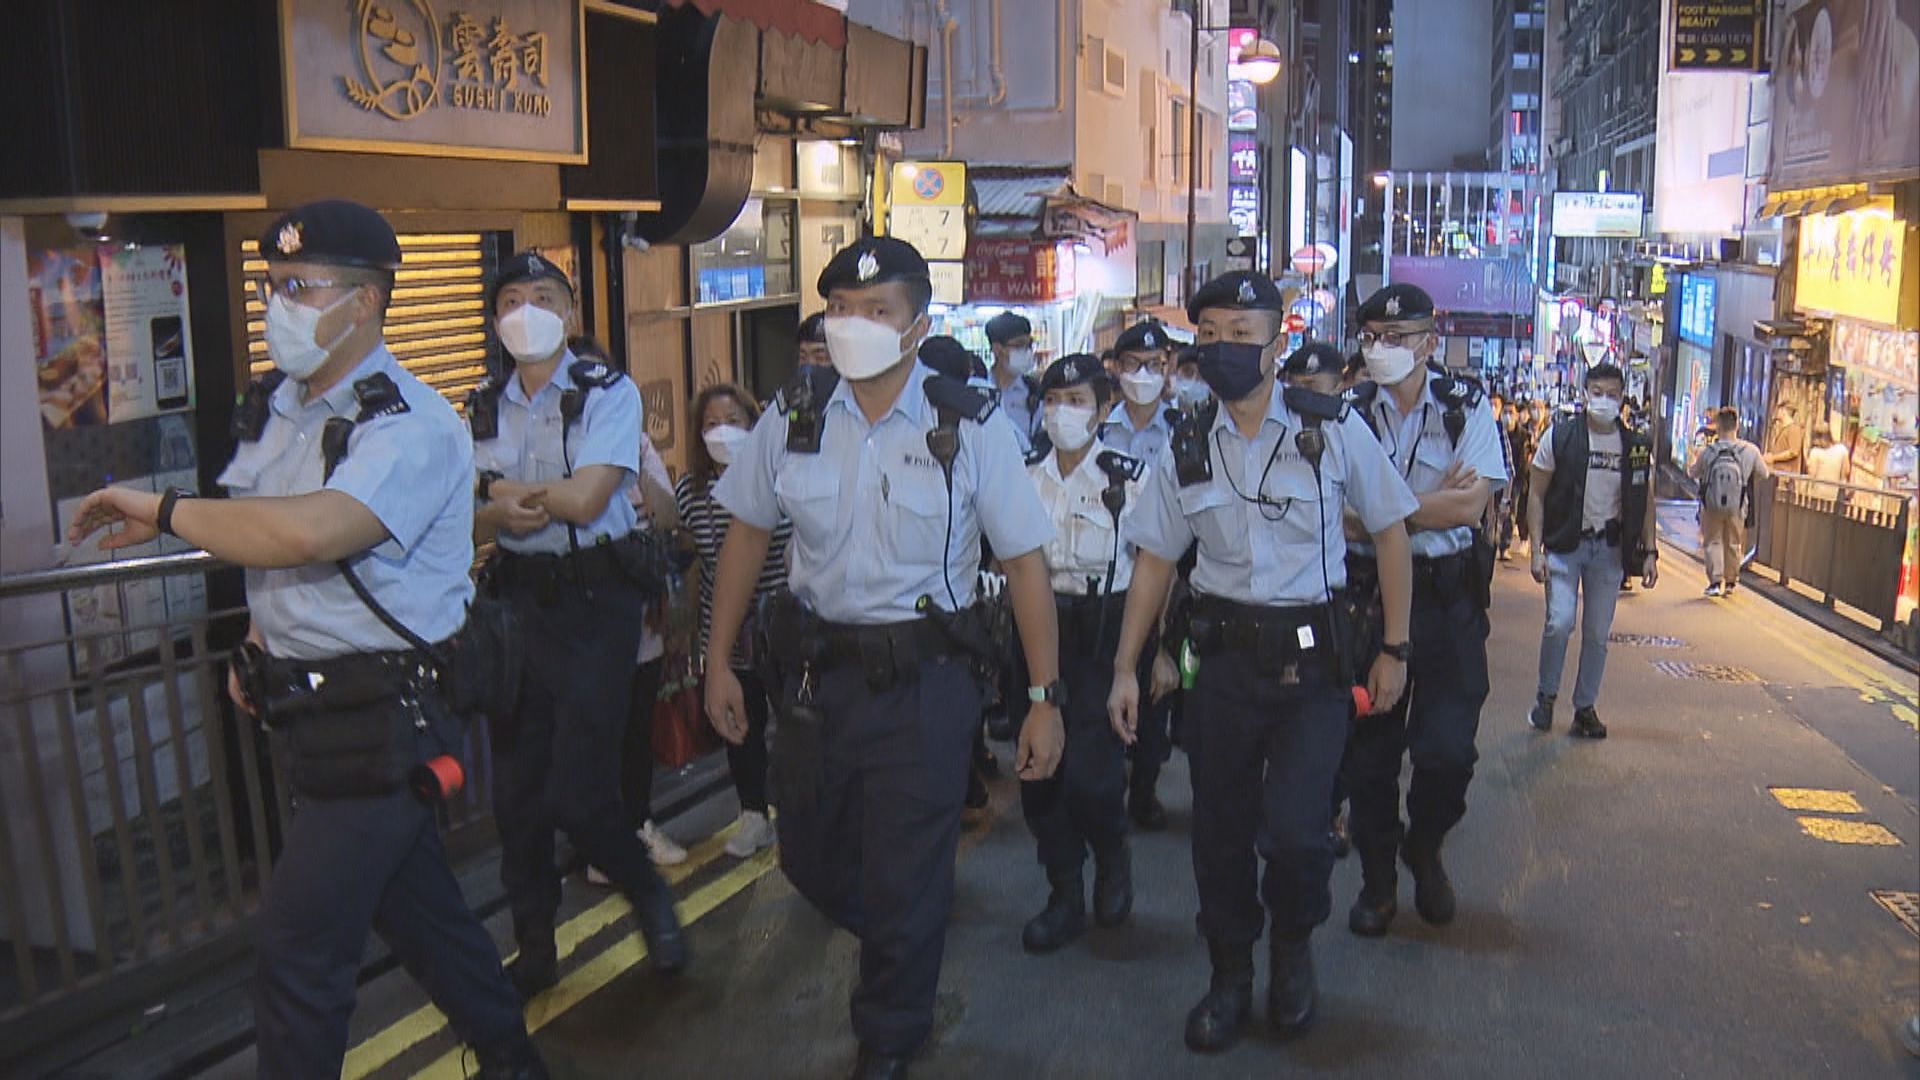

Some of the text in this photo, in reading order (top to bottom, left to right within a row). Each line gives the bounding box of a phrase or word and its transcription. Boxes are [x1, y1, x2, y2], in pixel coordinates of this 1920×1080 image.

[1679, 6, 1704, 15] FOOT
[1679, 16, 1719, 27] BEAUTY
[453, 84, 551, 117] SUSHI KUMO
[939, 209, 950, 226] 7
[938, 238, 948, 255] 7
[973, 283, 1000, 295] LEE
[1008, 283, 1041, 296] WAH
